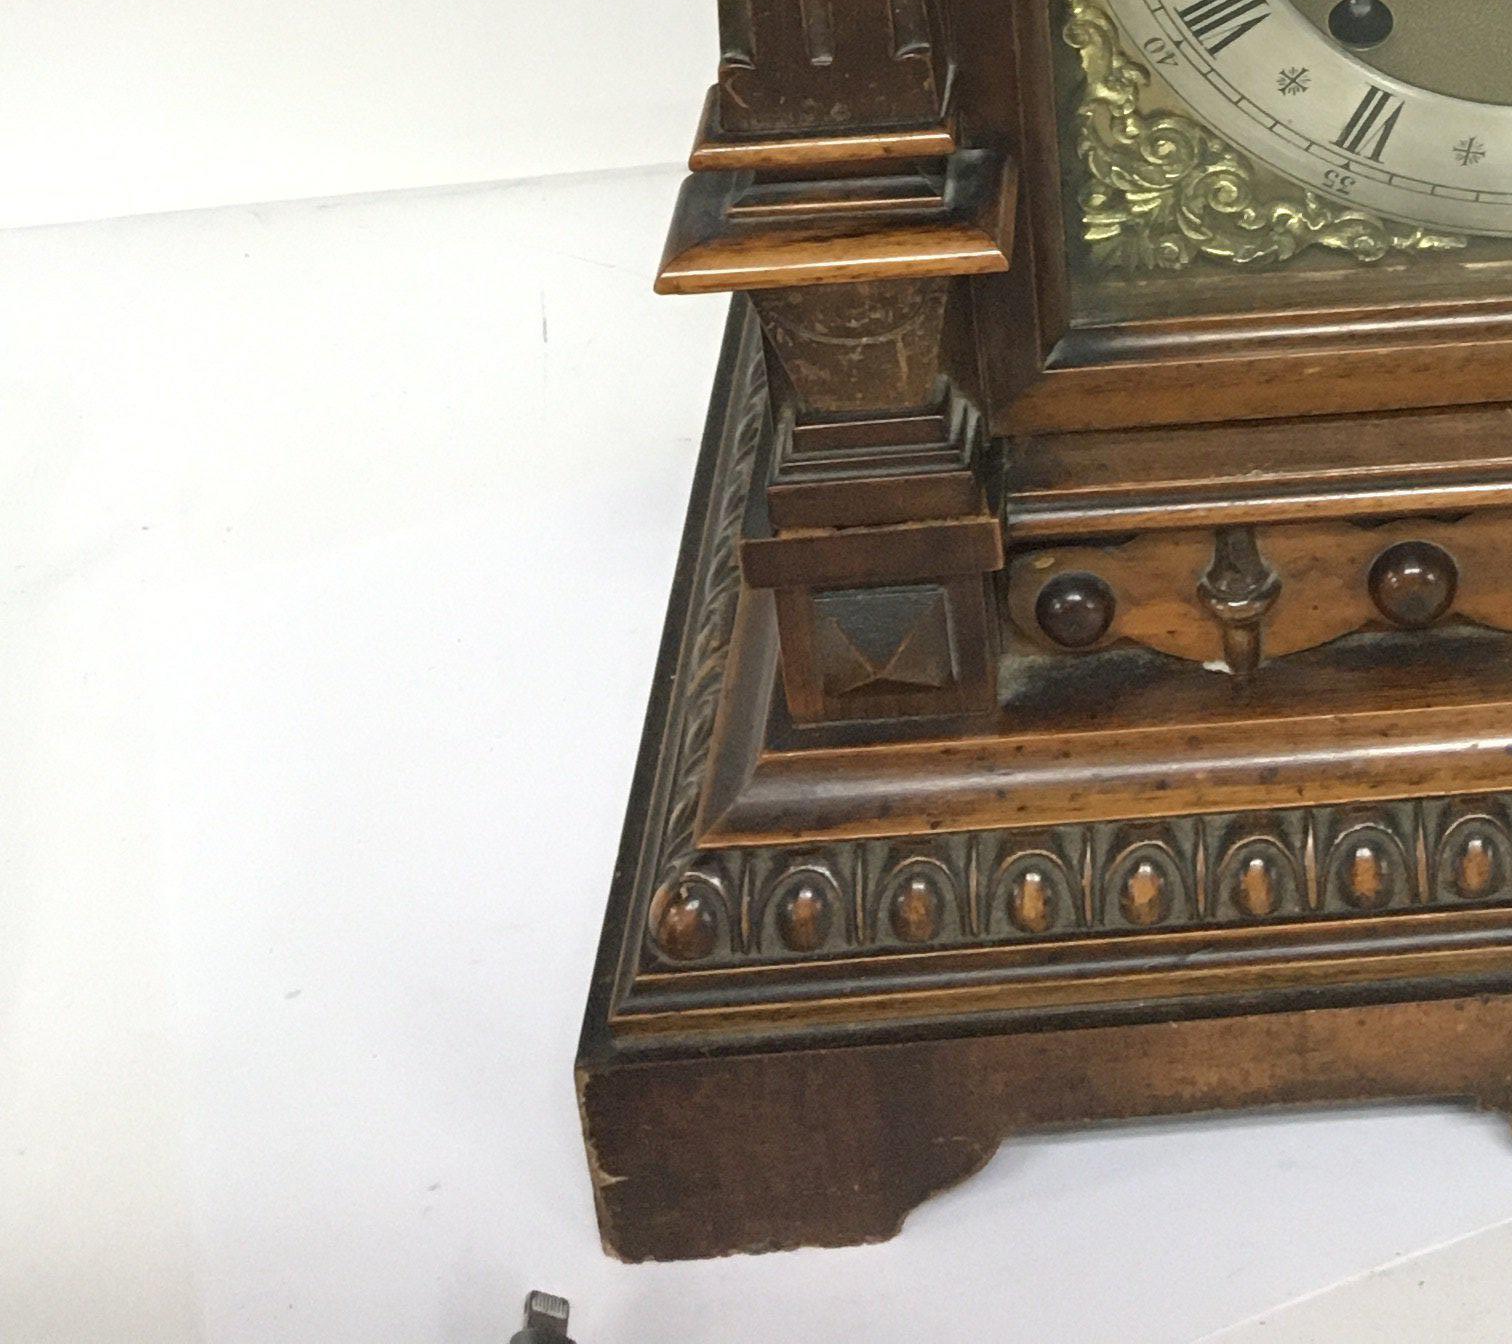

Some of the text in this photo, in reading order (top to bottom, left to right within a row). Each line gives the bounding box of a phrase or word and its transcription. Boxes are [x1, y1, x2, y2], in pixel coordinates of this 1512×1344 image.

[1141, 36, 1181, 69] 40
[1330, 84, 1406, 164] VII
[1323, 169, 1356, 195] 35
